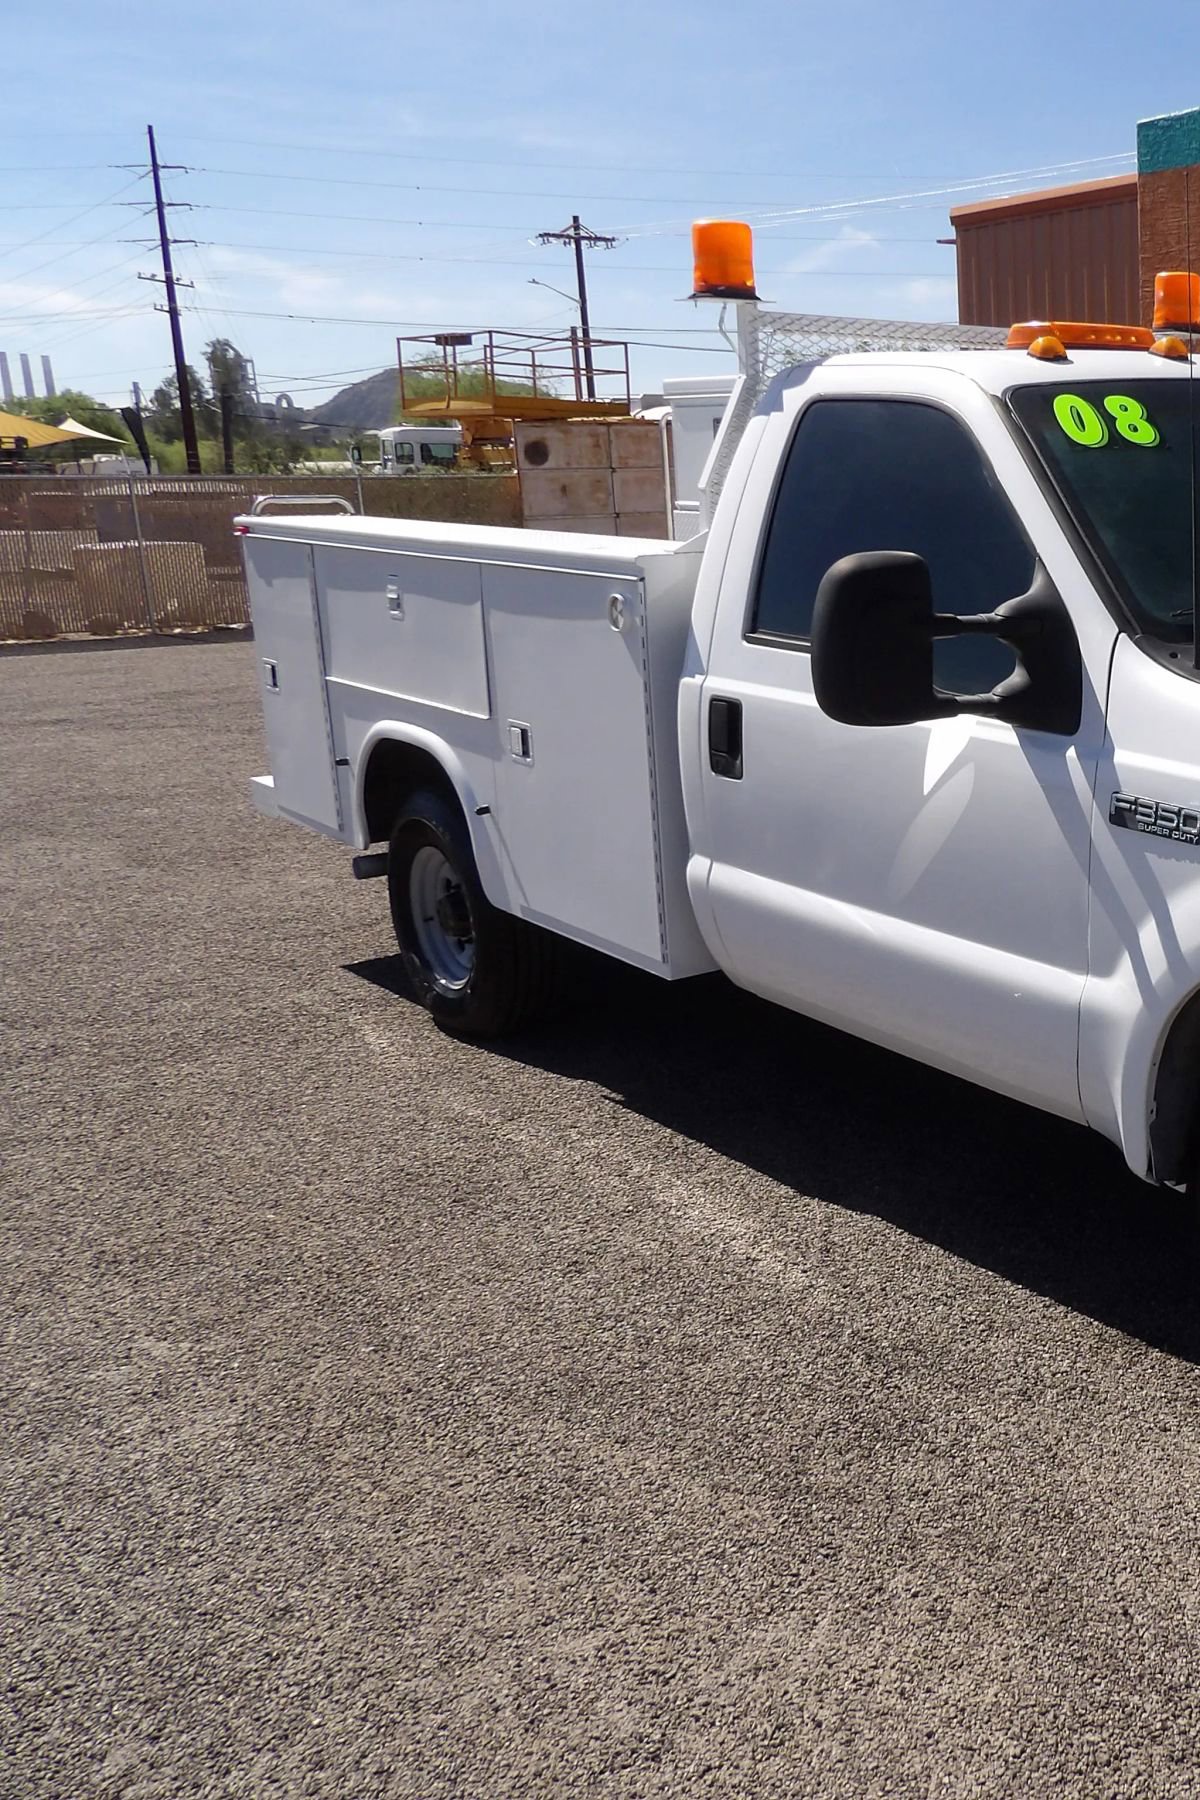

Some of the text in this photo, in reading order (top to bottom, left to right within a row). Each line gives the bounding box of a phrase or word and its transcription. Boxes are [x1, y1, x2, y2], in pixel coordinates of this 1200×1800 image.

[1053, 393, 1160, 448] 08
[1137, 822, 1200, 845] SUPER DUTY
